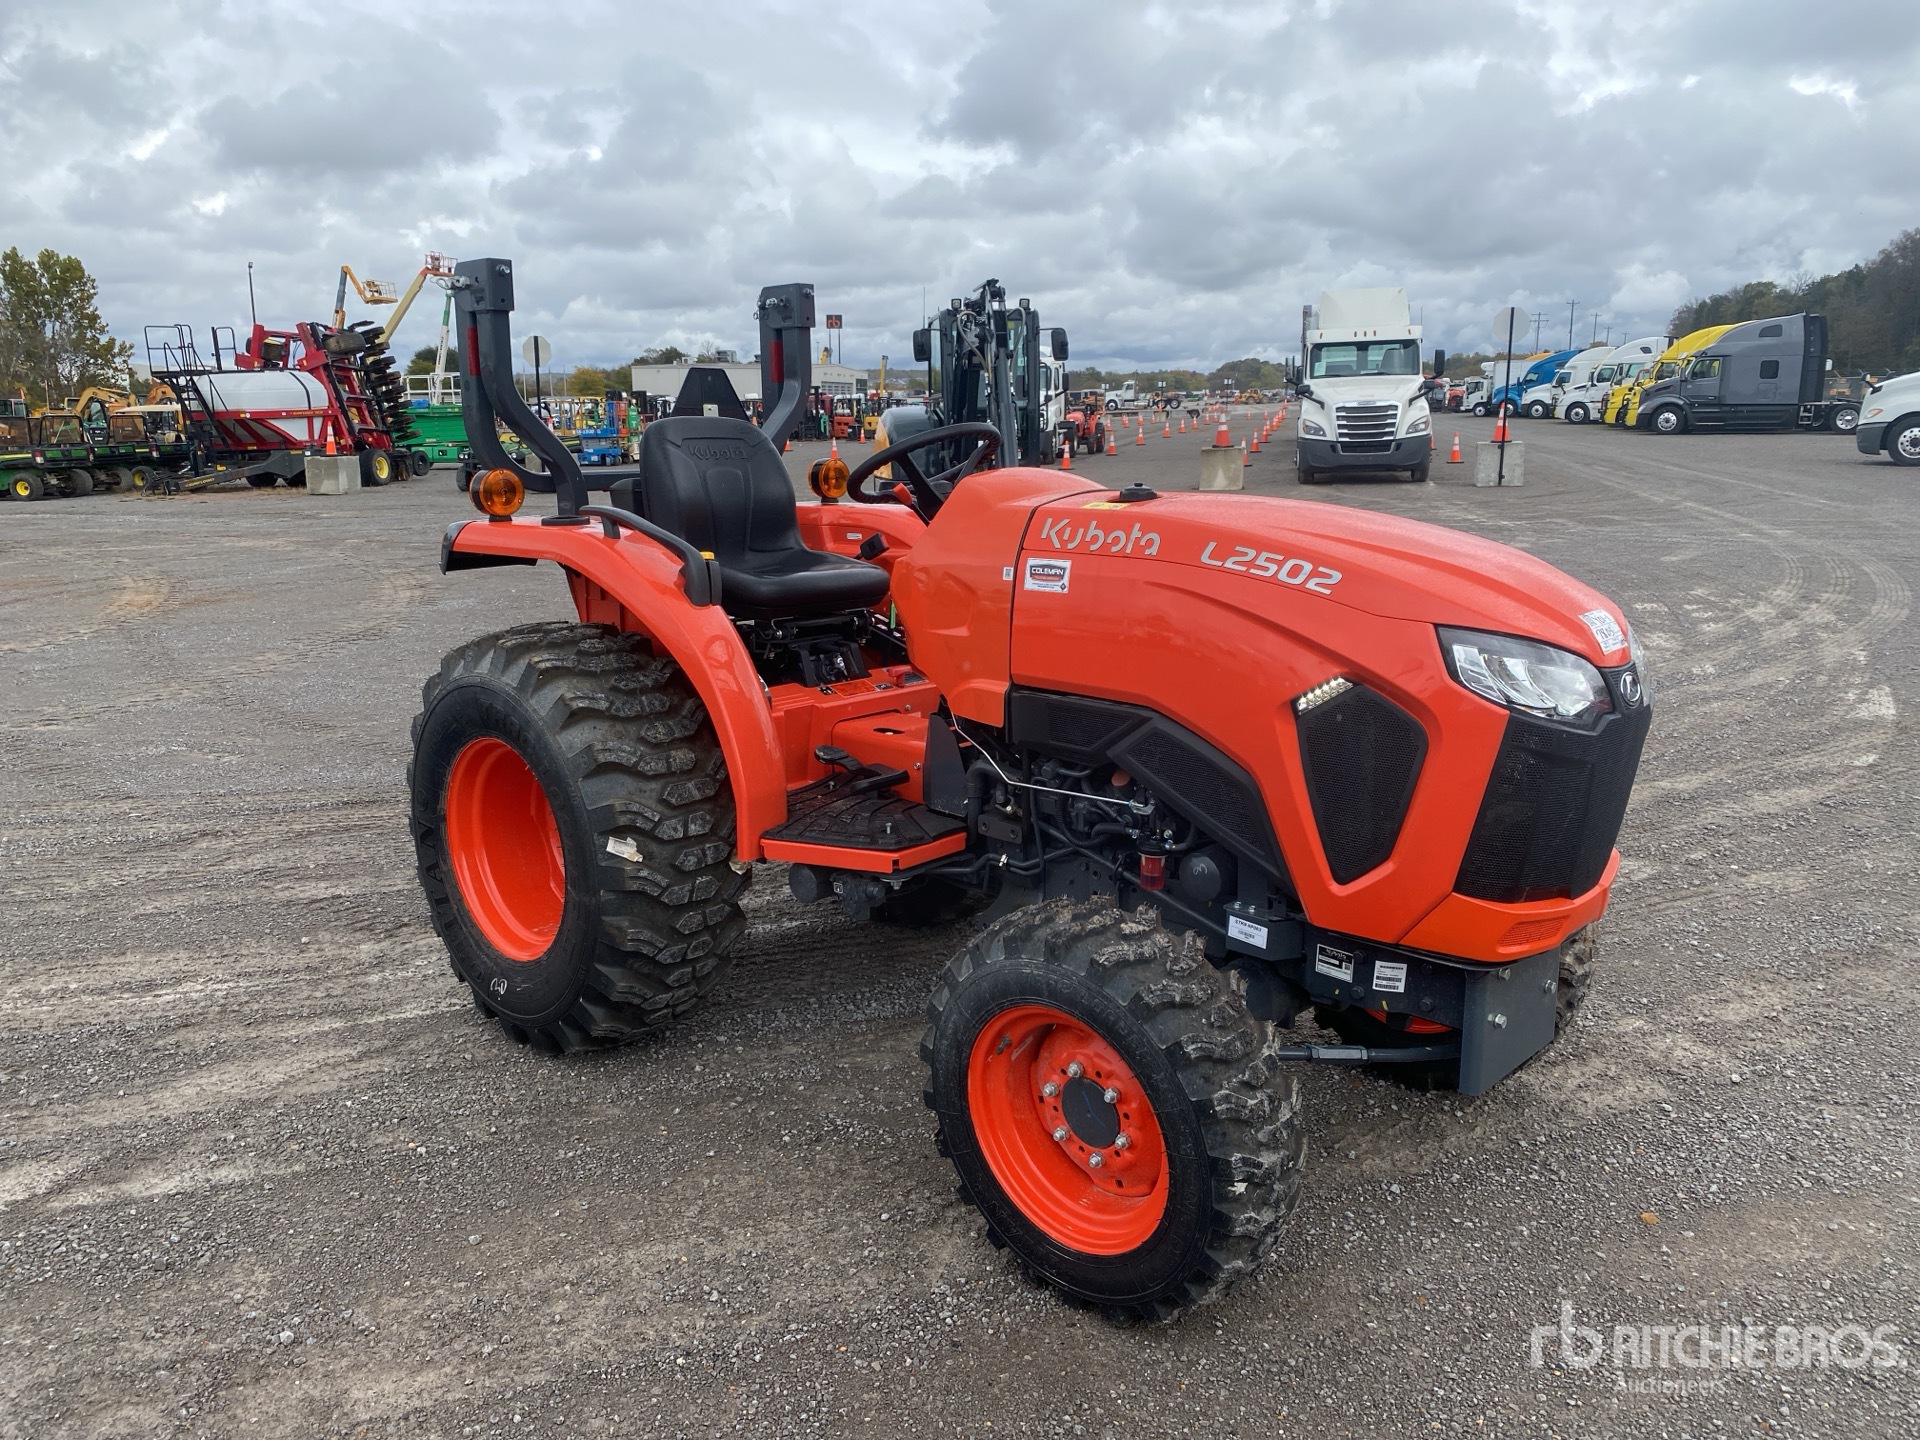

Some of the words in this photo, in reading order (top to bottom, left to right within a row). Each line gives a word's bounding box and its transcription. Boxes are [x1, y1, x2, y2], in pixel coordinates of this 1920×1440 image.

[827, 316, 840, 328] rb
[688, 444, 749, 460] Kubota
[1041, 518, 1161, 556] Kubota
[1200, 541, 1343, 595] L2502
[1031, 567, 1064, 576] COLEMAN
